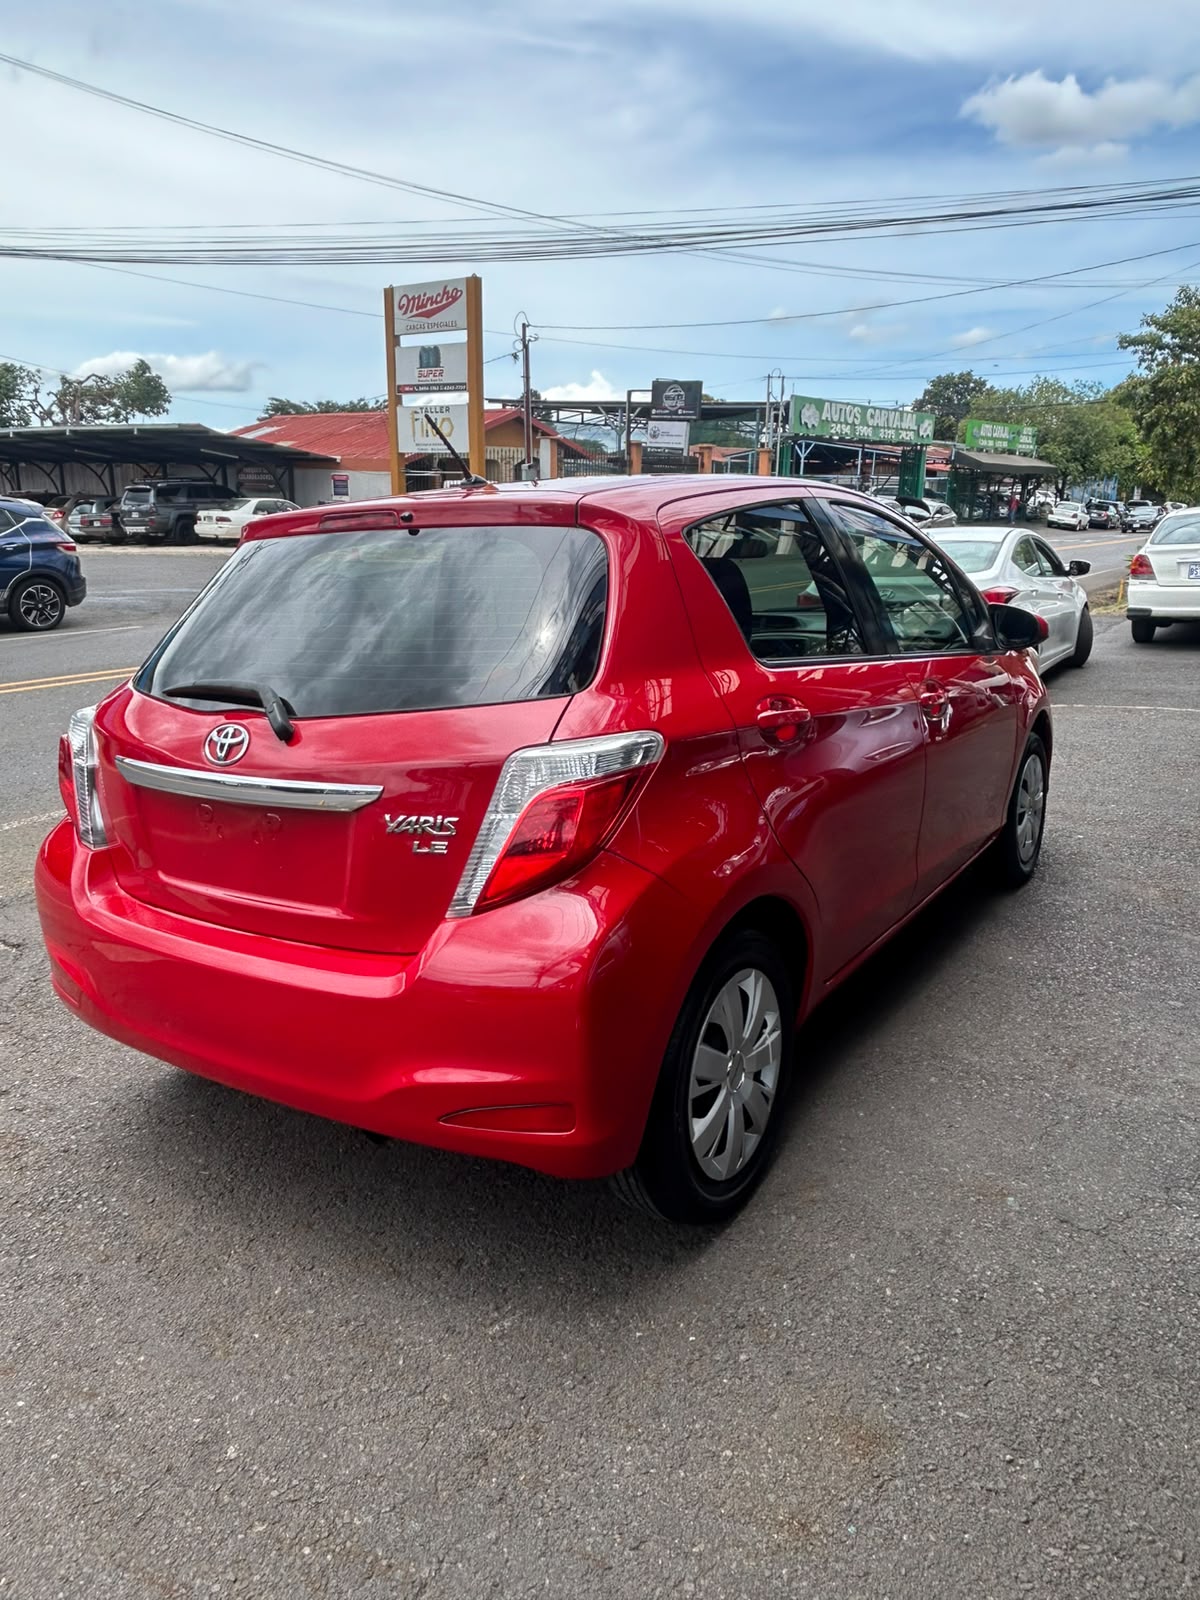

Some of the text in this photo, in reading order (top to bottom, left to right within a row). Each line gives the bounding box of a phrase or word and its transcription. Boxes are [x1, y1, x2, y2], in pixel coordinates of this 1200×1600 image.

[398, 284, 463, 316] Mincho
[427, 320, 457, 330] ESPECIALES
[418, 369, 444, 378] SUPER
[420, 406, 451, 414] TALLER
[821, 401, 918, 430] AUTOS CARVAJAL
[384, 813, 460, 836] YARIS
[412, 841, 449, 855] LE
